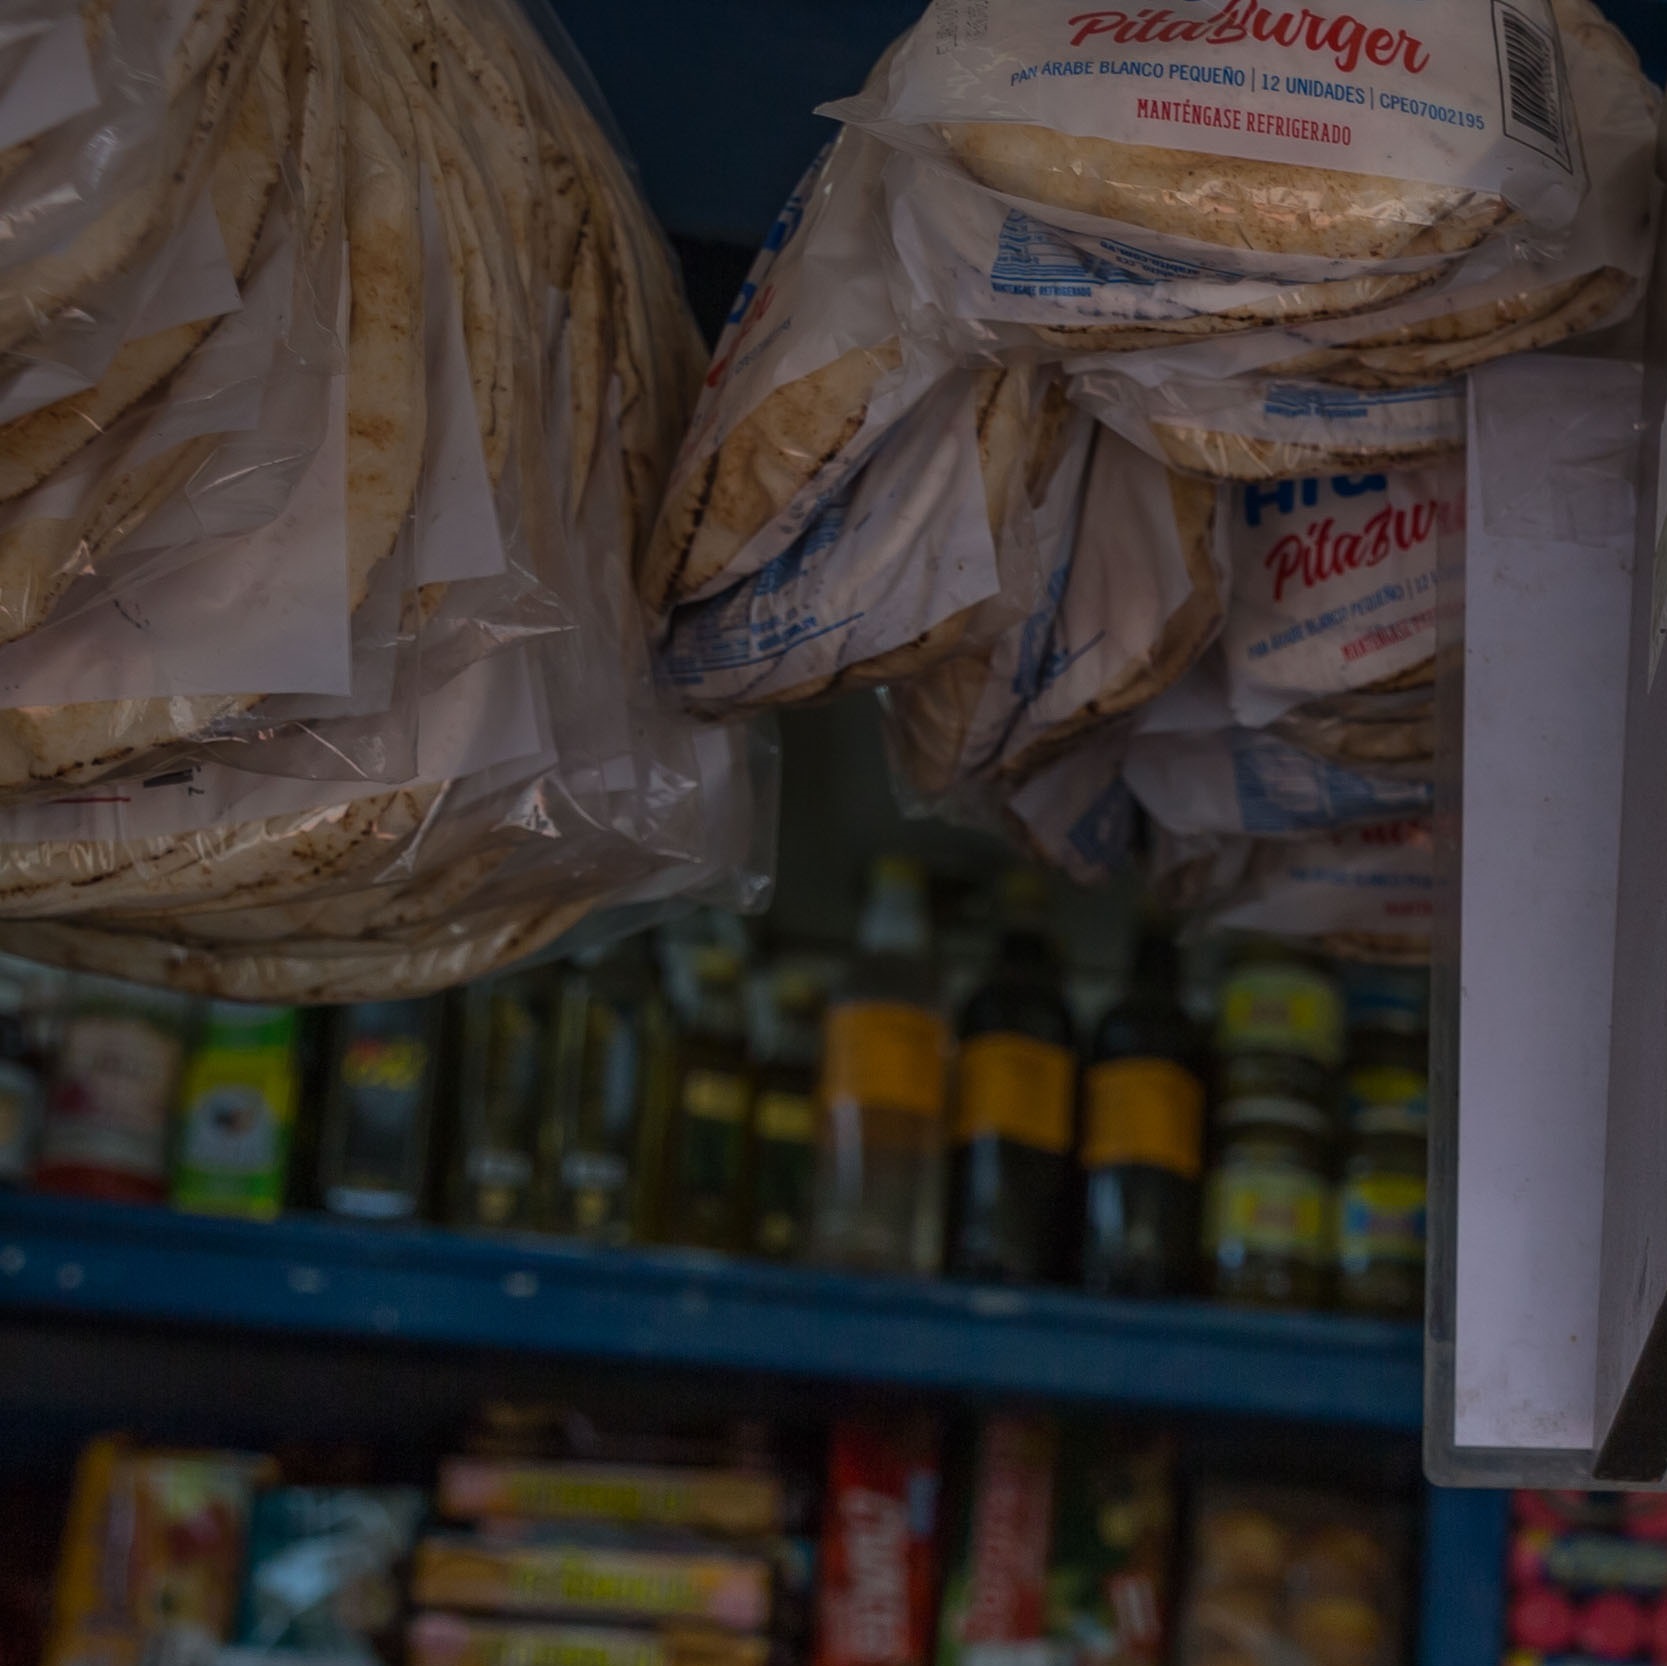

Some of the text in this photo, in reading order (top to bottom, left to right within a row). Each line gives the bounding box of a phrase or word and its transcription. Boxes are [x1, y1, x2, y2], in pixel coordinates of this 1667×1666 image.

[1068, 0, 1430, 75] PitaBurger
[1010, 65, 1038, 86] PAN
[1099, 61, 1164, 79] BLANCO
[1168, 65, 1245, 87] PEQUEÑO
[1261, 75, 1280, 92] 12
[1286, 78, 1366, 105] UNIDADES
[1379, 93, 1485, 130] CPE07002195
[1136, 98, 1352, 146] MANTÉNGASE REFRIGERADO
